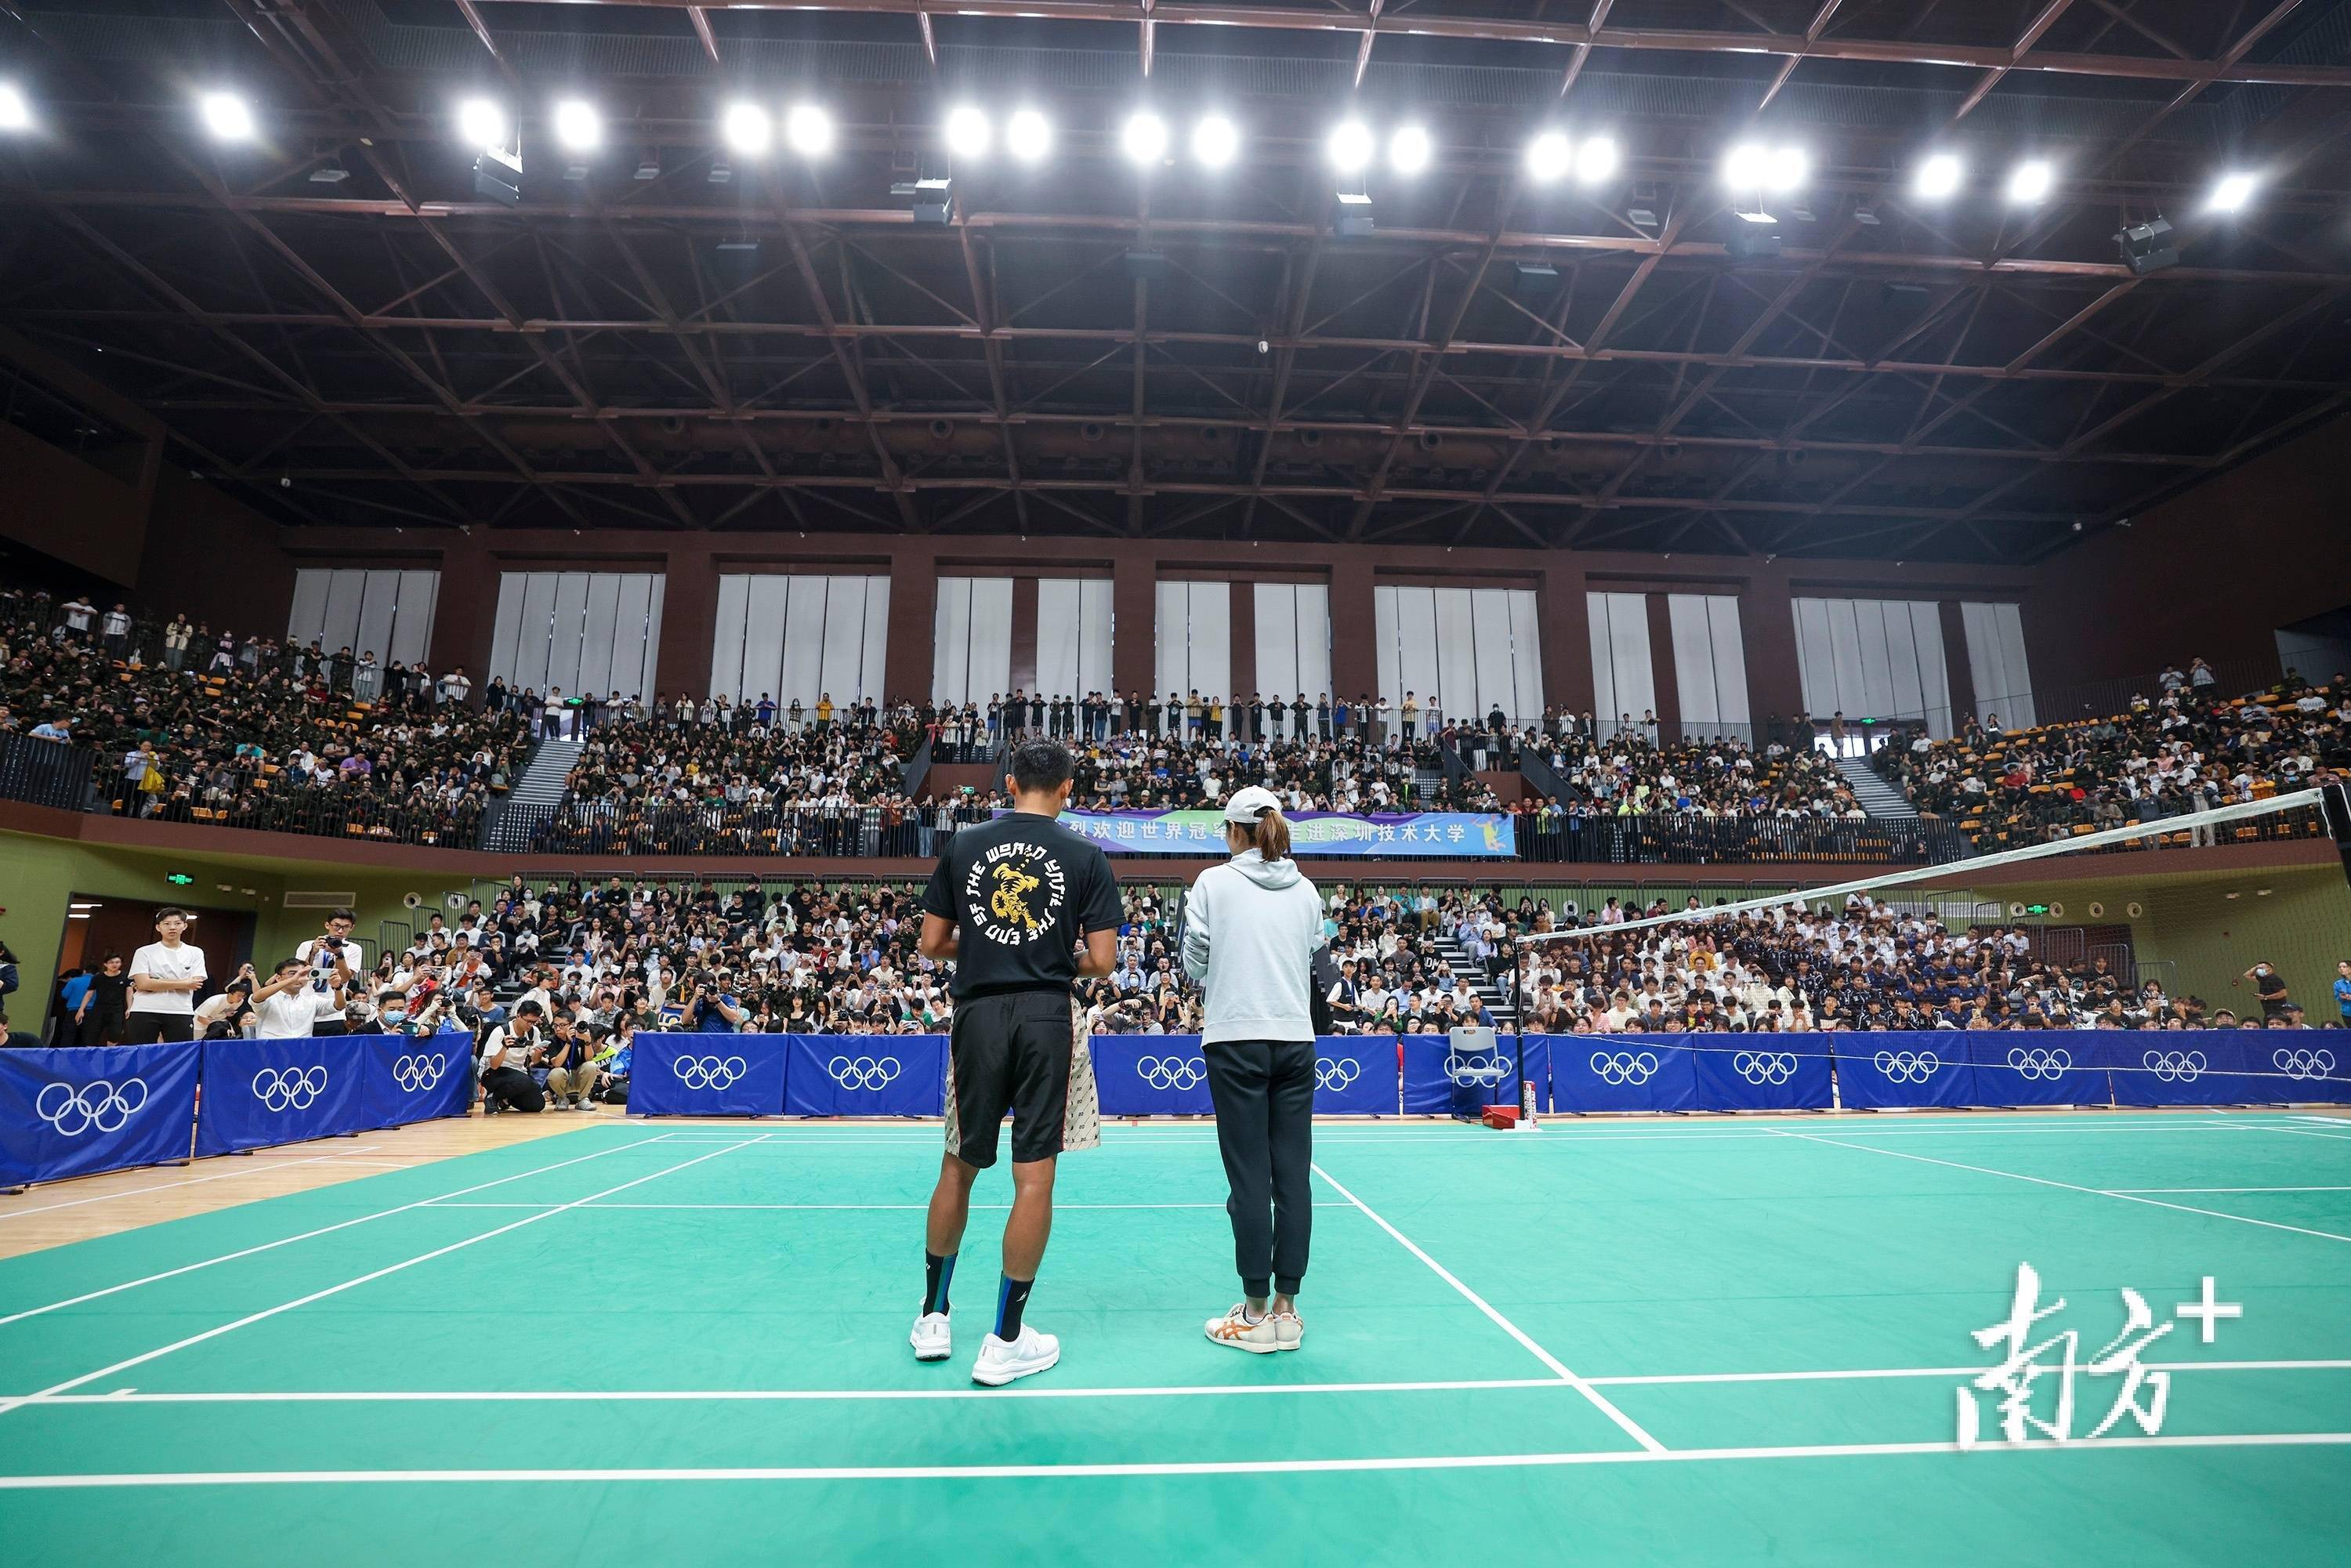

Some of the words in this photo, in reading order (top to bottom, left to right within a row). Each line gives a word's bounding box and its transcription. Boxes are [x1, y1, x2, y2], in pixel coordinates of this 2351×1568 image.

[1055, 820, 1225, 841] 烈欢迎世界冠军
[985, 842, 1048, 864] WORLD
[965, 860, 986, 898] THE
[969, 903, 987, 927] OF
[1026, 907, 1056, 942] THE
[984, 924, 1021, 946] END
